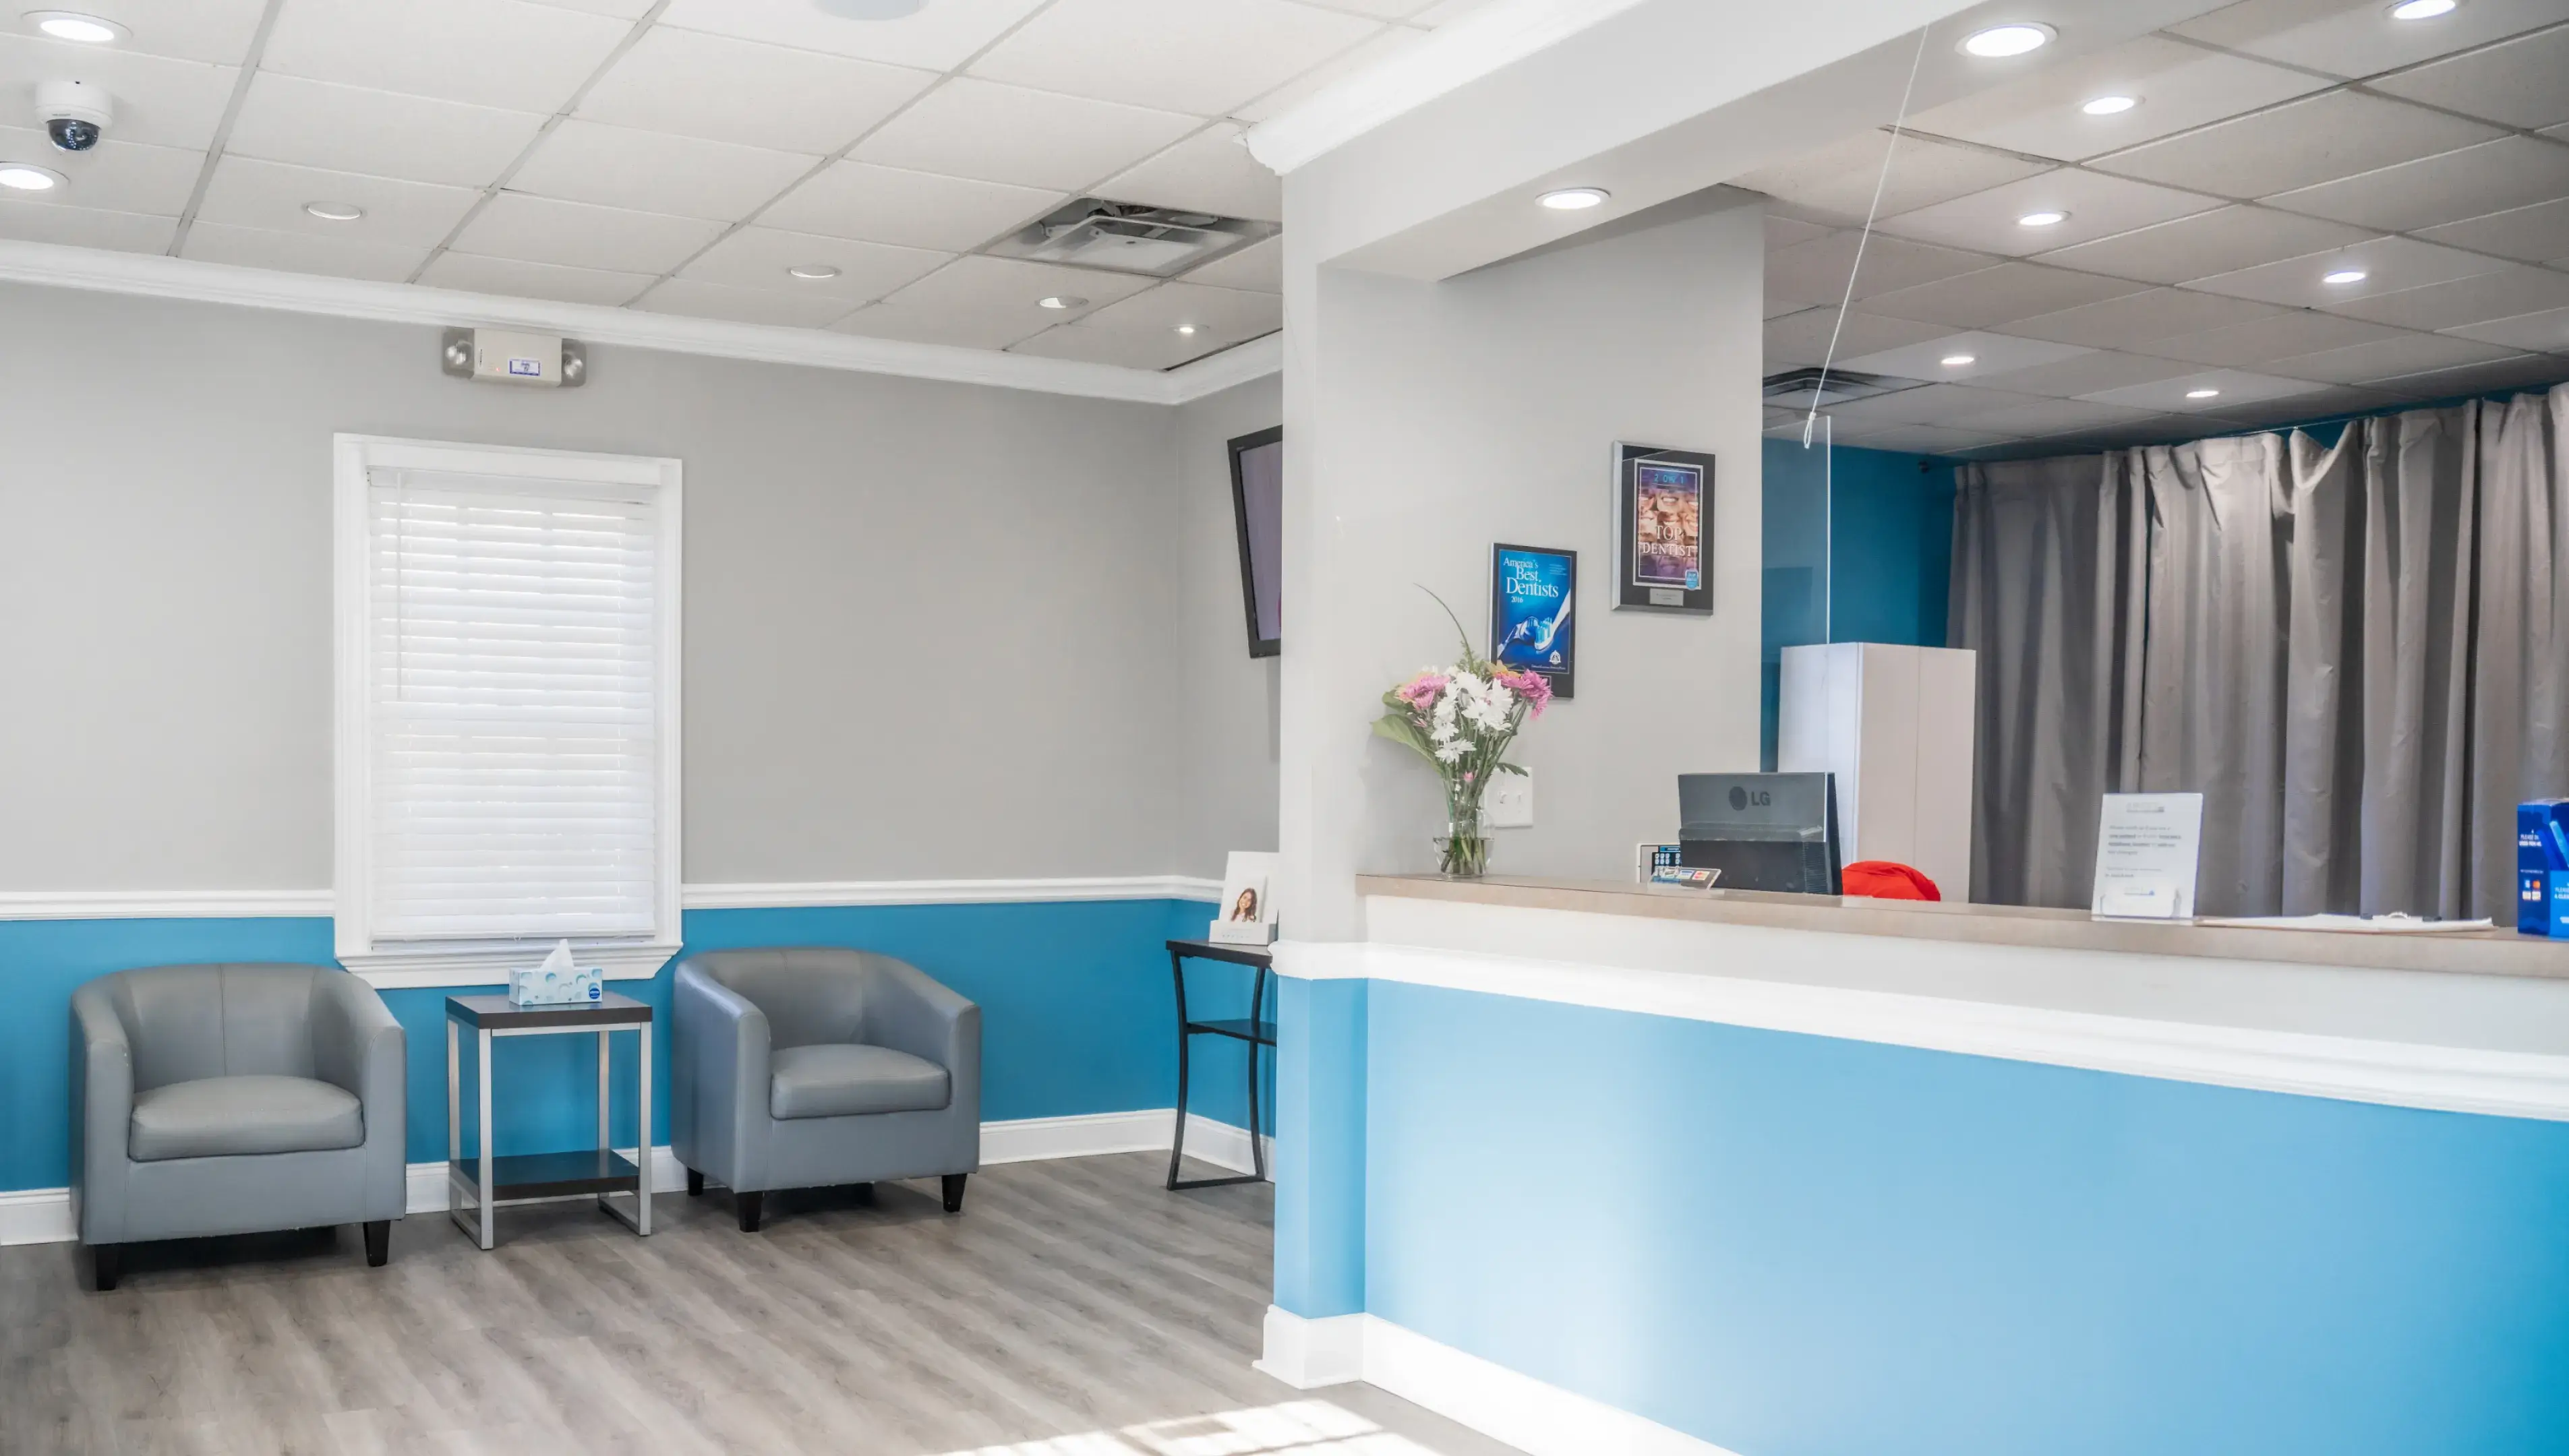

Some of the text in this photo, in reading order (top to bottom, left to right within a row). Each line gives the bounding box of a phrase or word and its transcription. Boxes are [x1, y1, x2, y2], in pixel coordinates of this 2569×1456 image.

[1656, 525, 1683, 541] TOP
[1643, 542, 1694, 557] DENTIST
[1503, 557, 1539, 569] America's
[1516, 566, 1539, 581] Best
[1506, 576, 1559, 597] Dentists
[1750, 791, 1771, 806] LG
